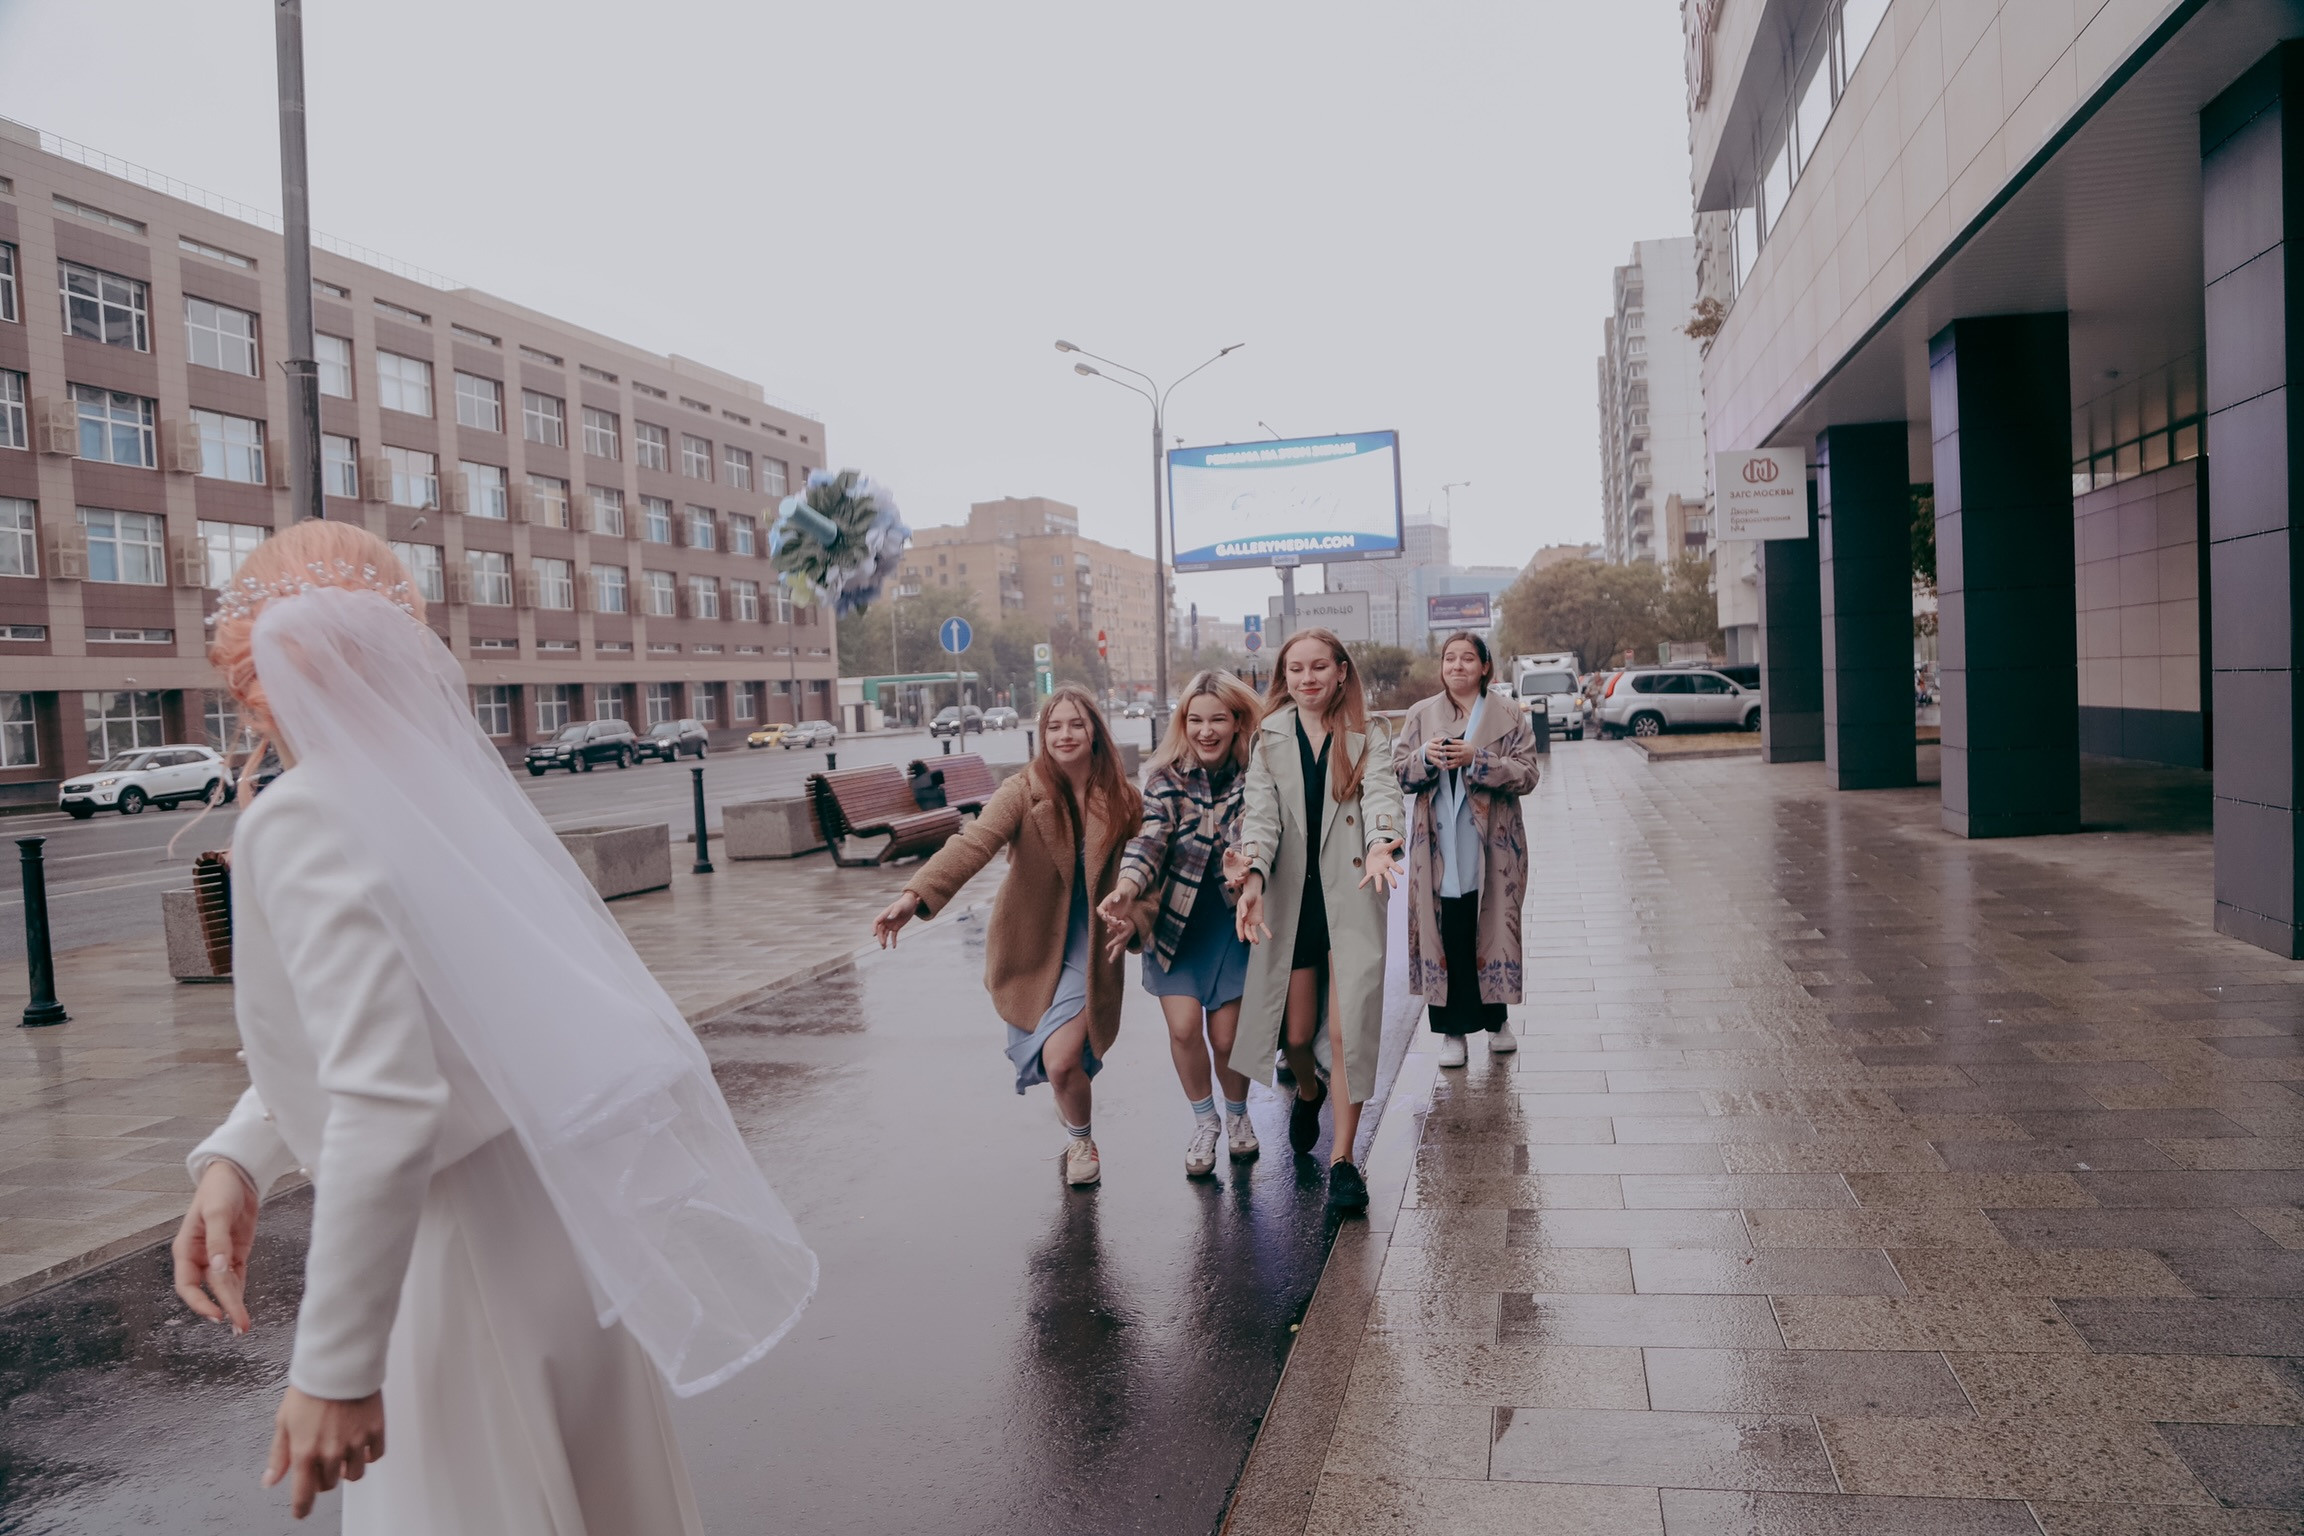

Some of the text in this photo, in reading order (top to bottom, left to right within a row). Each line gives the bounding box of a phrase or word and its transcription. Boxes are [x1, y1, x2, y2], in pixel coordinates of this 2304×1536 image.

[1729, 487, 1794, 499] ЗАГС МОСКВЫ
[1730, 507, 1759, 516] Дворец
[1215, 535, 1355, 557] GALLERYMEDIA.COM
